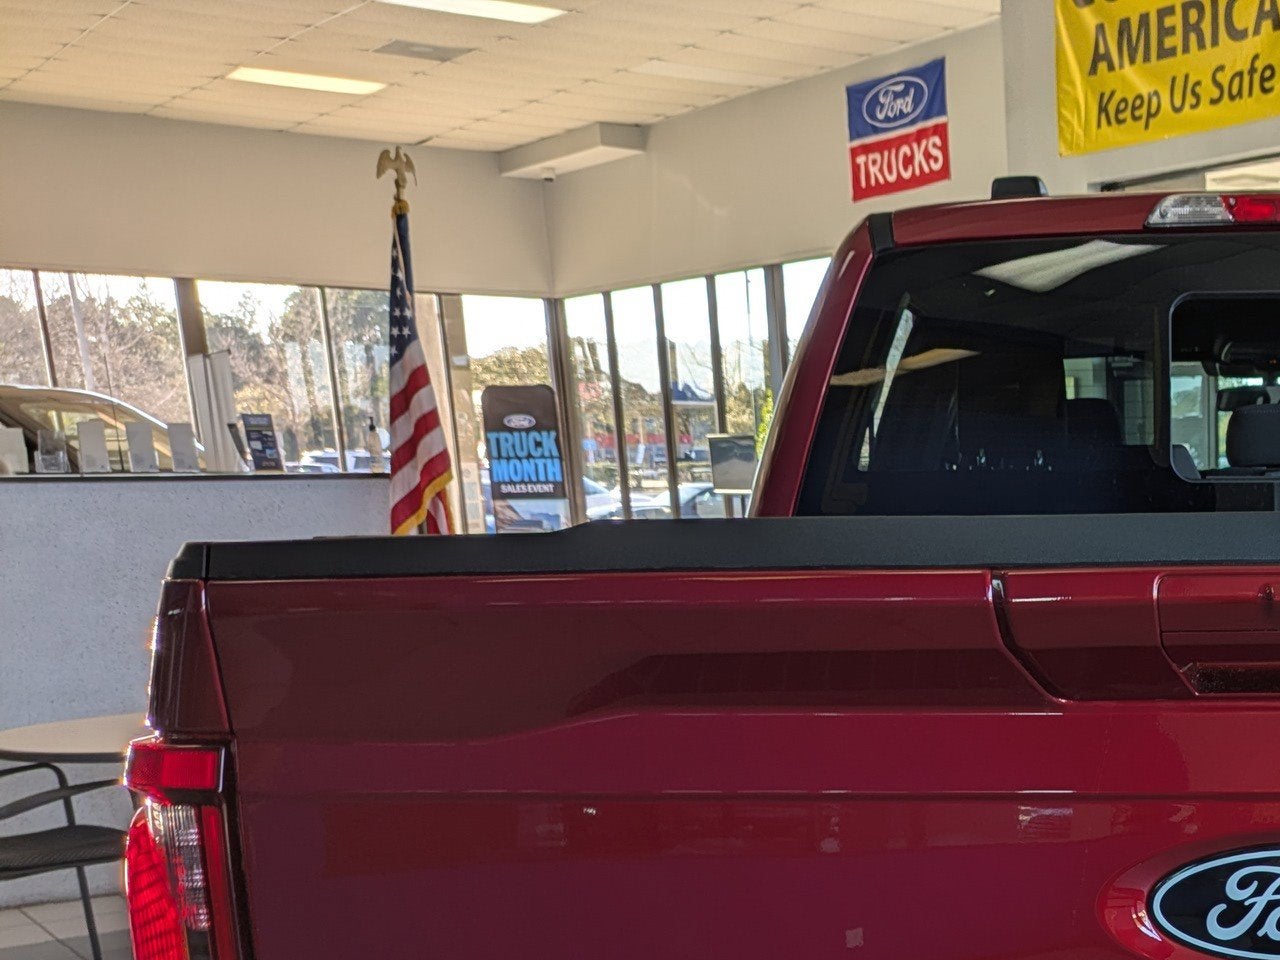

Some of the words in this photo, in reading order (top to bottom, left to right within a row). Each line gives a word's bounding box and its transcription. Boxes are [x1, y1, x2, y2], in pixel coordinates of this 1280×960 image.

[875, 82, 915, 120] Ford
[1097, 90, 1161, 130] Keep
[1169, 73, 1202, 114] Us
[1209, 53, 1276, 105] Safe
[856, 135, 944, 189] TRUCKS
[487, 431, 559, 458] TRUCK
[491, 458, 563, 482] MONTH
[500, 484, 528, 493] SALES
[527, 484, 554, 493] EVENT
